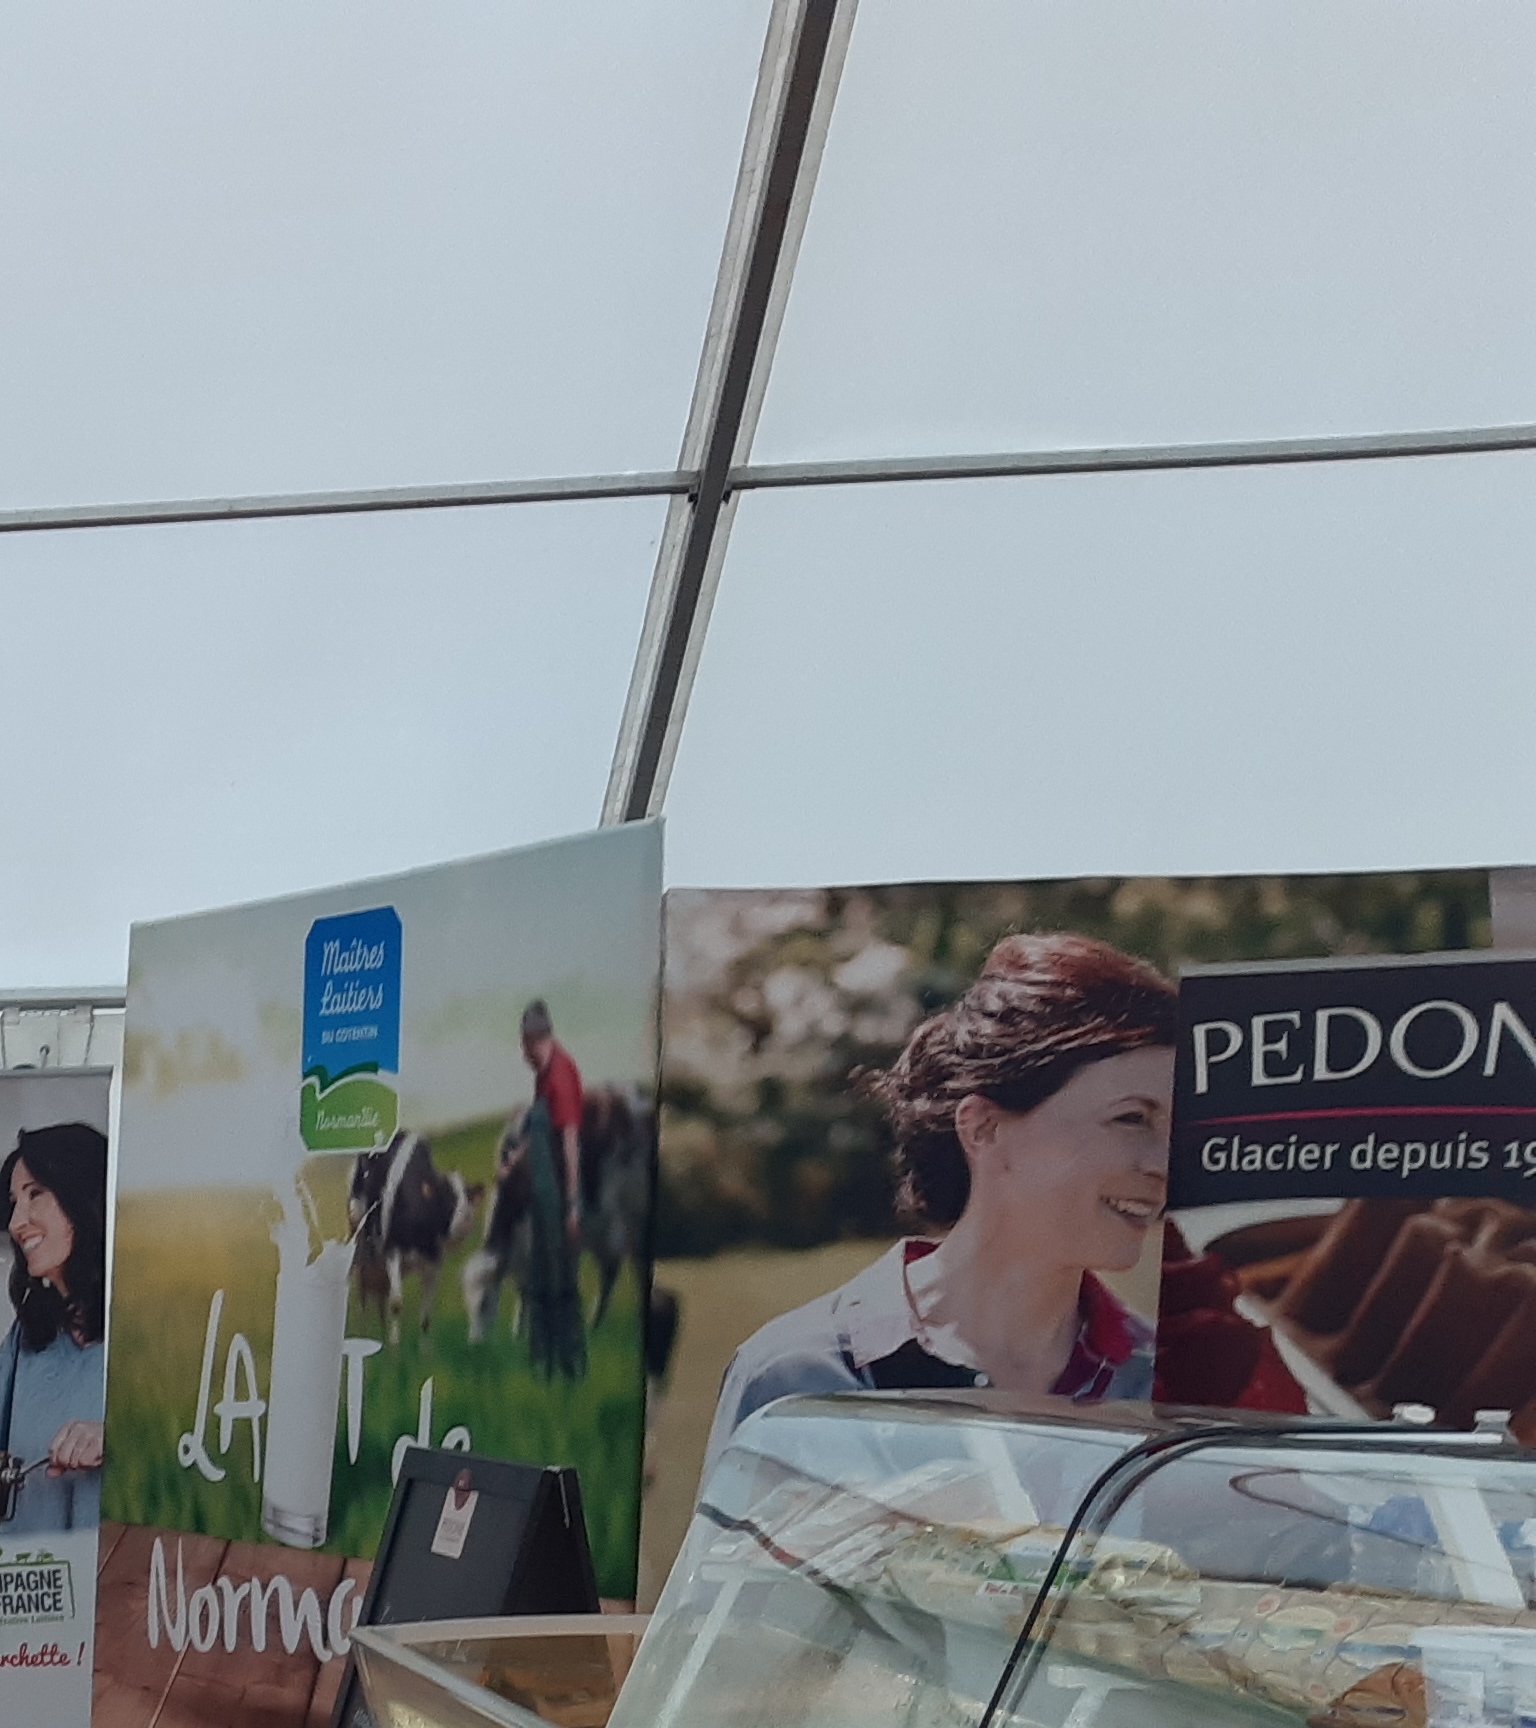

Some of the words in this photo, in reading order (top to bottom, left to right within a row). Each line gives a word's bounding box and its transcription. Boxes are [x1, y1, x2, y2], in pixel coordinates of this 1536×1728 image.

[321, 936, 384, 976] Maîtres
[319, 980, 383, 1016] Laitiers
[1201, 1134, 1339, 1172] Glacier
[1350, 1132, 1490, 1178] depuis
[147, 1536, 364, 1661] Norma
[77, 1641, 86, 1667] !
